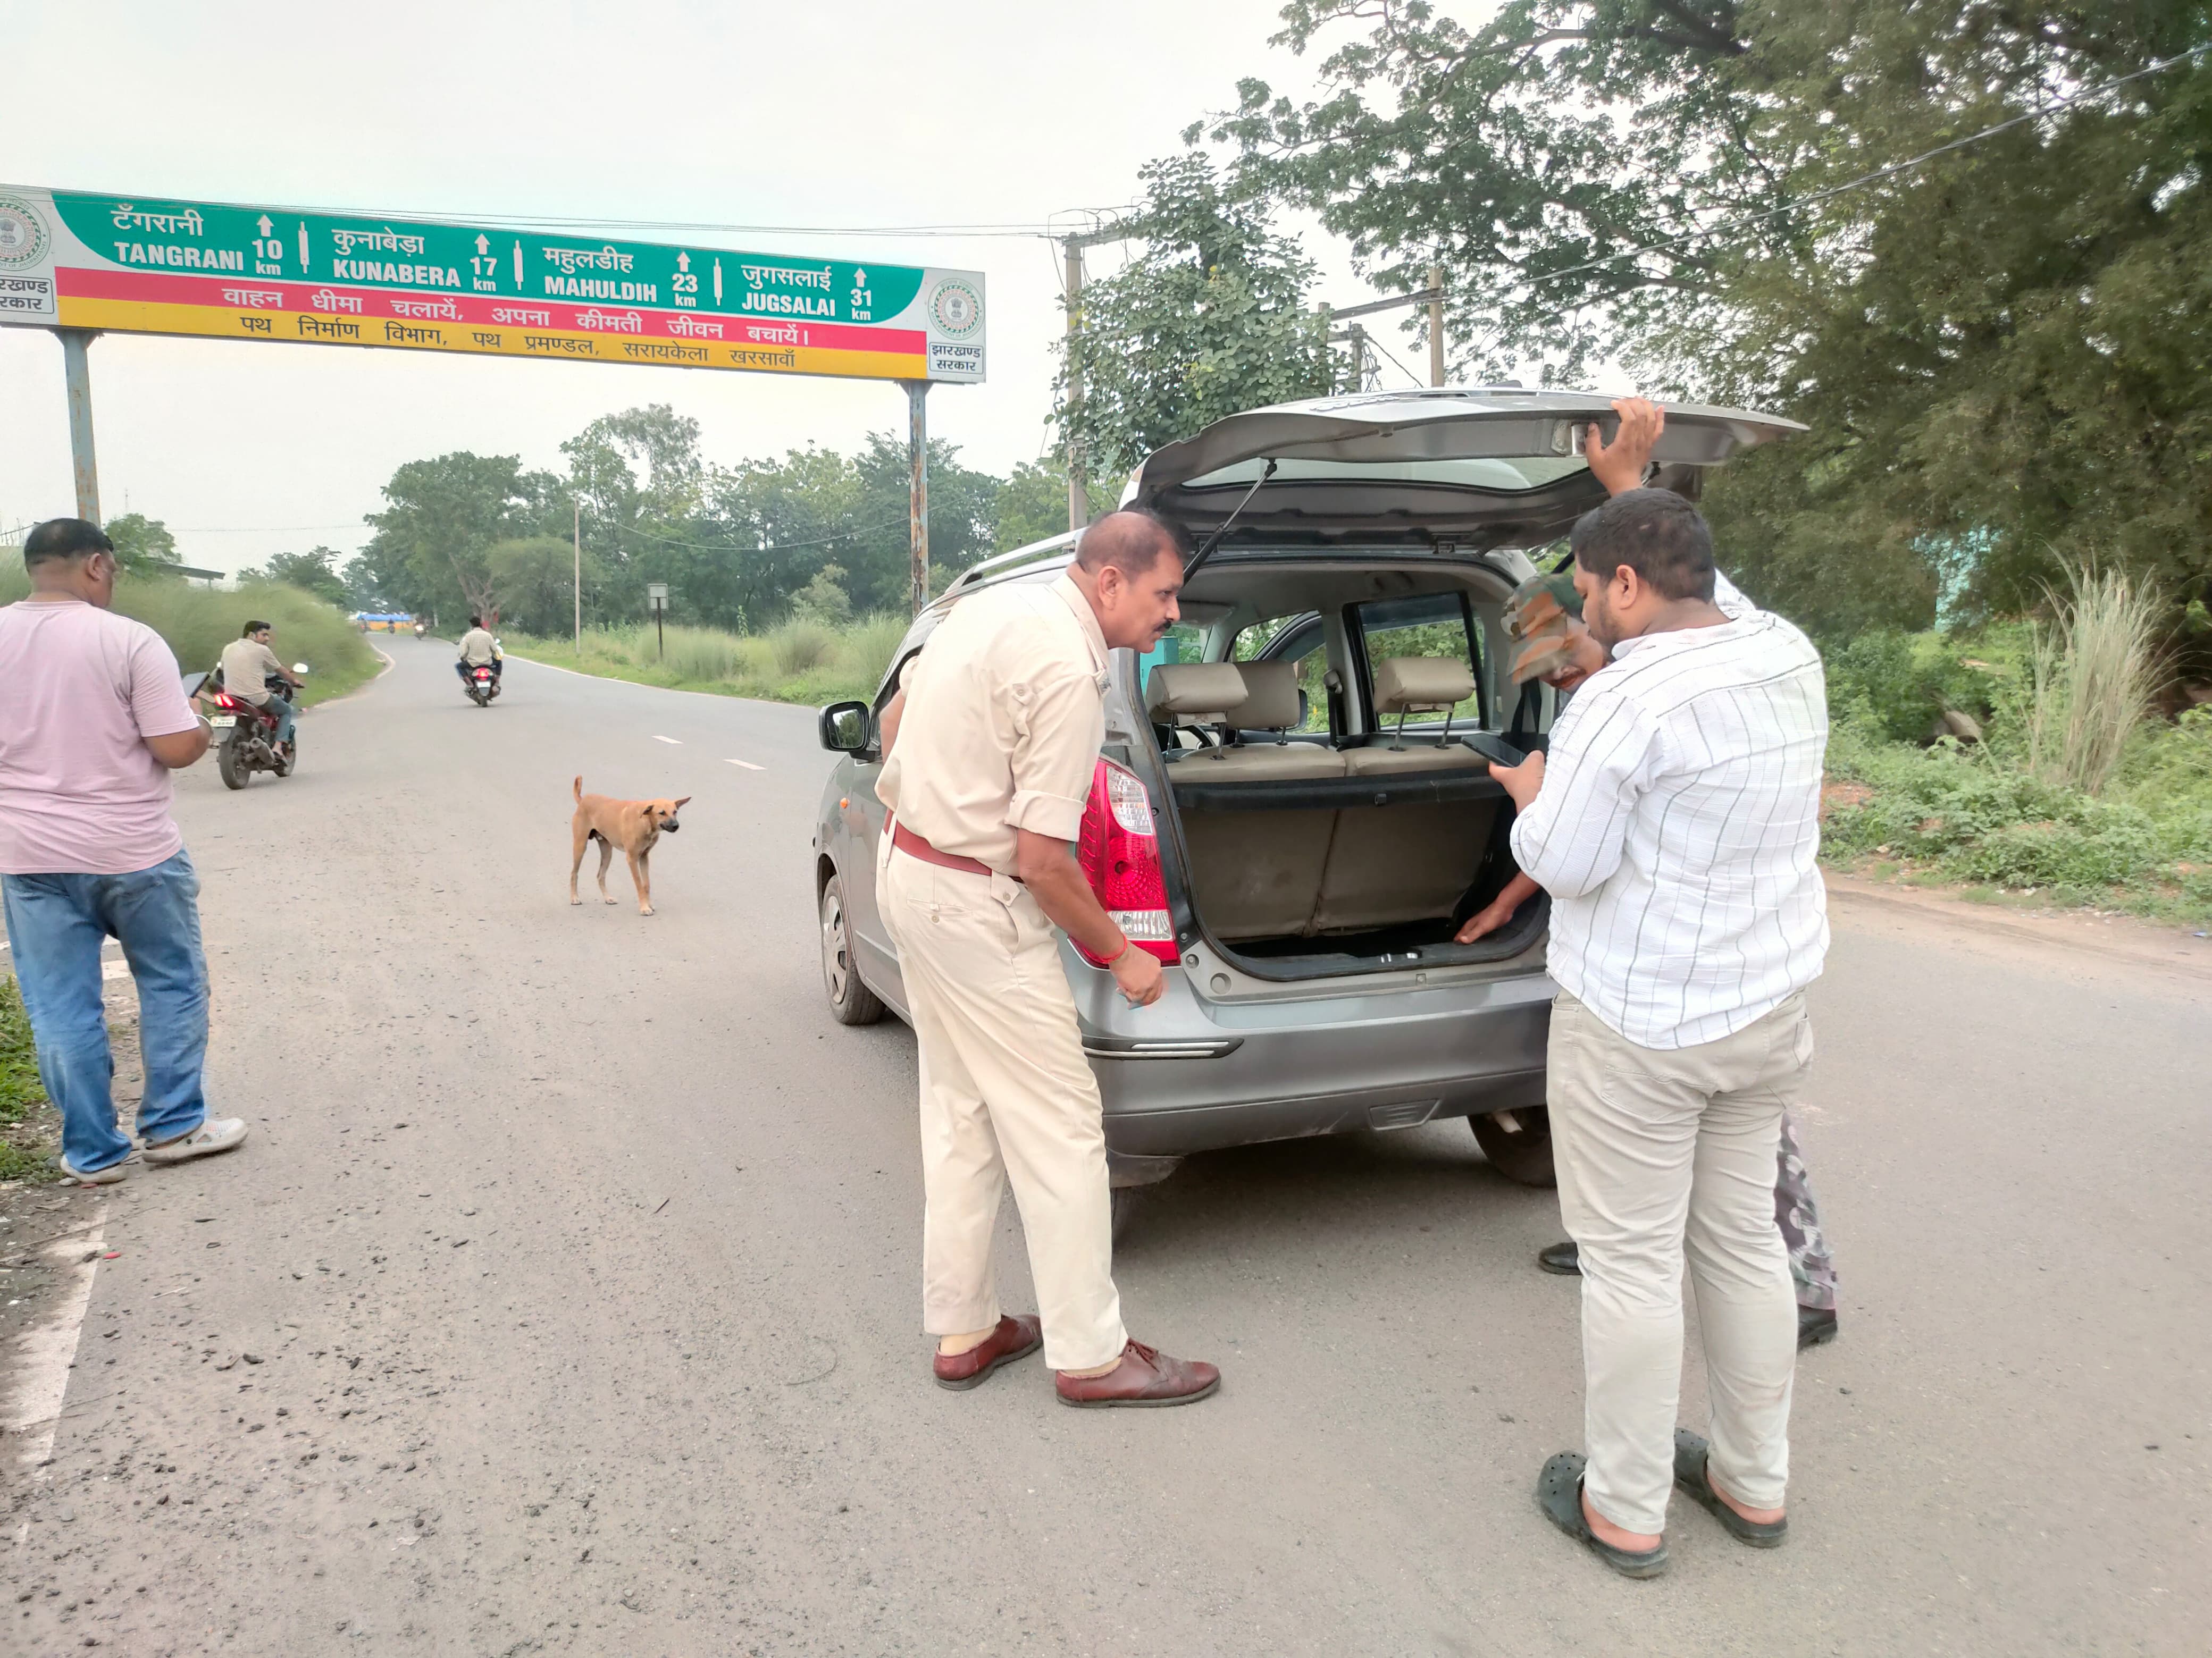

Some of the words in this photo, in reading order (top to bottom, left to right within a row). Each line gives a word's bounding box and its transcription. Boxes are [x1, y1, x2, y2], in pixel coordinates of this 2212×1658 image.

[252, 239, 283, 260] 10
[331, 226, 425, 257] कुनाबेड़ा
[114, 241, 244, 271] TANGRANI
[470, 256, 497, 276] 17
[542, 245, 634, 274] महुलडीह
[255, 260, 281, 275] km
[333, 258, 461, 288] KUNABERA
[0, 279, 49, 293] रखण्ड
[473, 277, 496, 292] km
[544, 275, 657, 302] MAHULDIH
[672, 273, 698, 292] 23
[741, 265, 832, 292] जुगसलाई
[0, 297, 43, 310] रकार
[675, 293, 696, 307] km
[742, 292, 835, 316] JUGSALAI
[850, 288, 872, 307] 31
[222, 288, 283, 308] वाहन
[311, 289, 363, 313] धीमा
[390, 297, 464, 321] चलायें,
[491, 307, 550, 326] अपना
[575, 309, 643, 333] कीमती
[666, 315, 724, 339] जीवन
[851, 307, 871, 321] km
[240, 317, 272, 333] पथ
[297, 315, 359, 339] निर्माण
[384, 321, 447, 346] विभाग,
[472, 332, 501, 347] पथ
[524, 336, 599, 356] प्रमण्डल,
[622, 341, 709, 361] सरायकेला
[729, 348, 795, 367] खरसावाँ
[931, 344, 981, 358] झारखण्ड
[936, 359, 976, 371] सरकार
